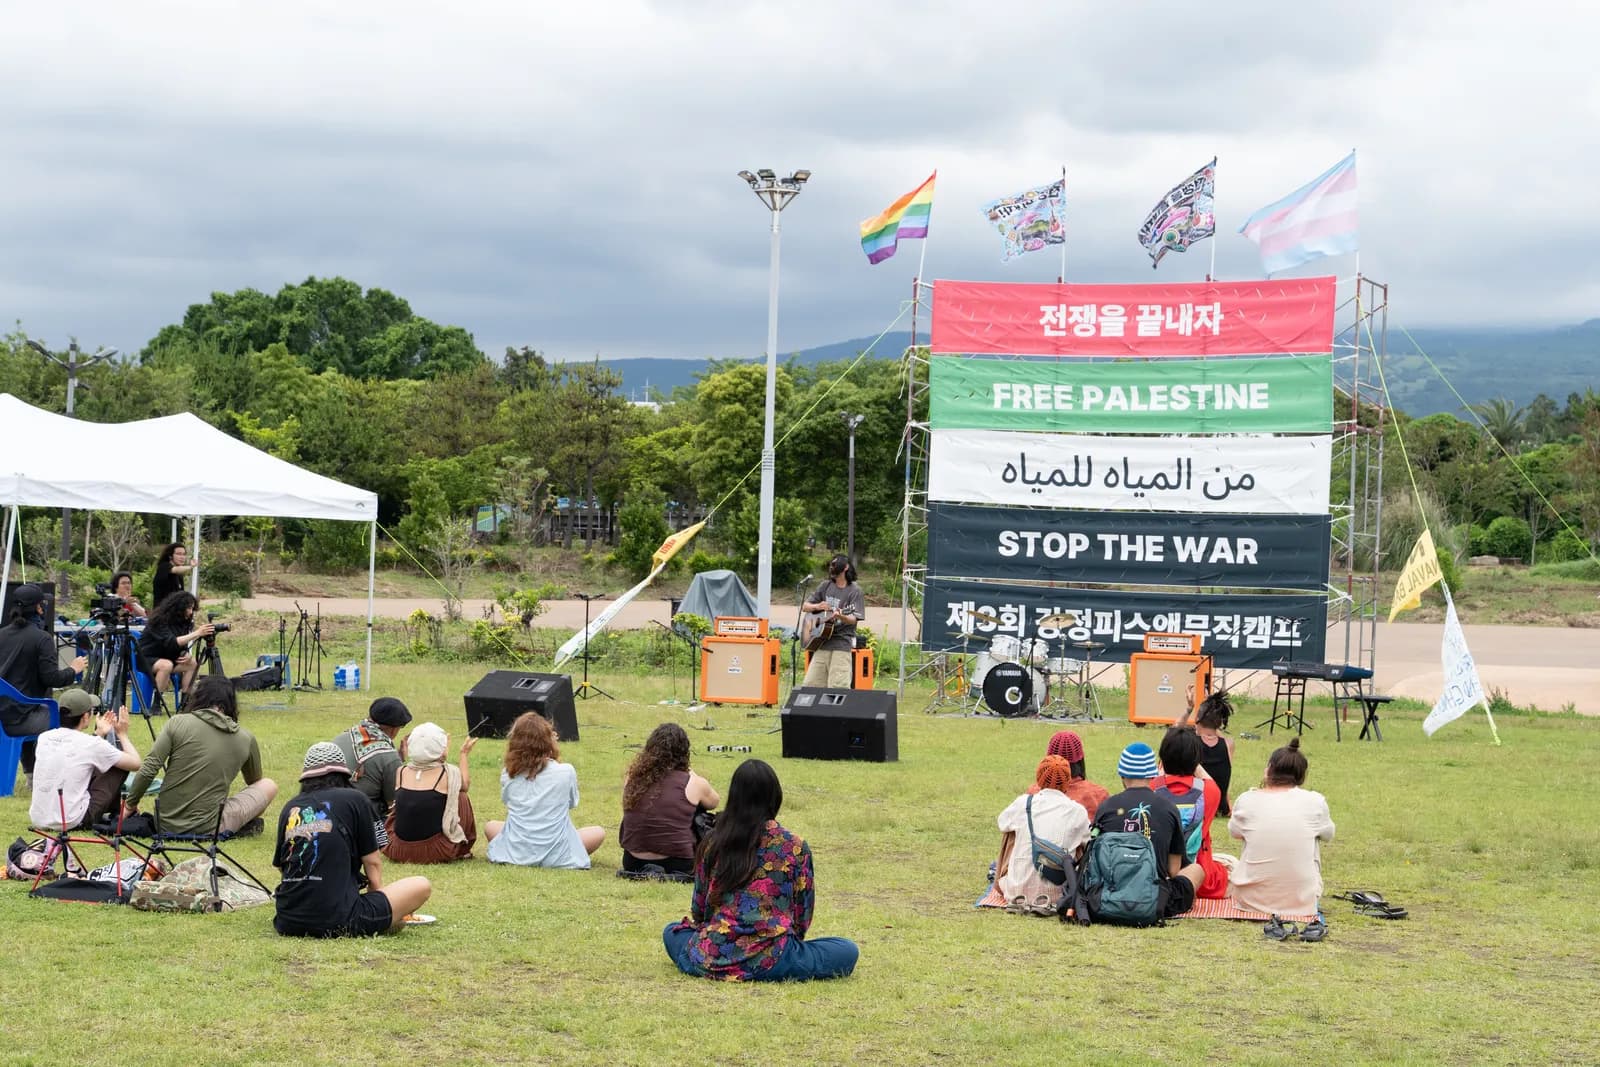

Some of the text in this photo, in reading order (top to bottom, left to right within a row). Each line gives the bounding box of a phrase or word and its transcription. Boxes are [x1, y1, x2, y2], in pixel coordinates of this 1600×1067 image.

[1039, 302, 1224, 337] 전쟁을 끝내자
[993, 383, 1269, 411] FREE PALESTINE
[1001, 452, 1255, 501] من المياه للمياه
[998, 530, 1259, 565] STOP THE WAR
